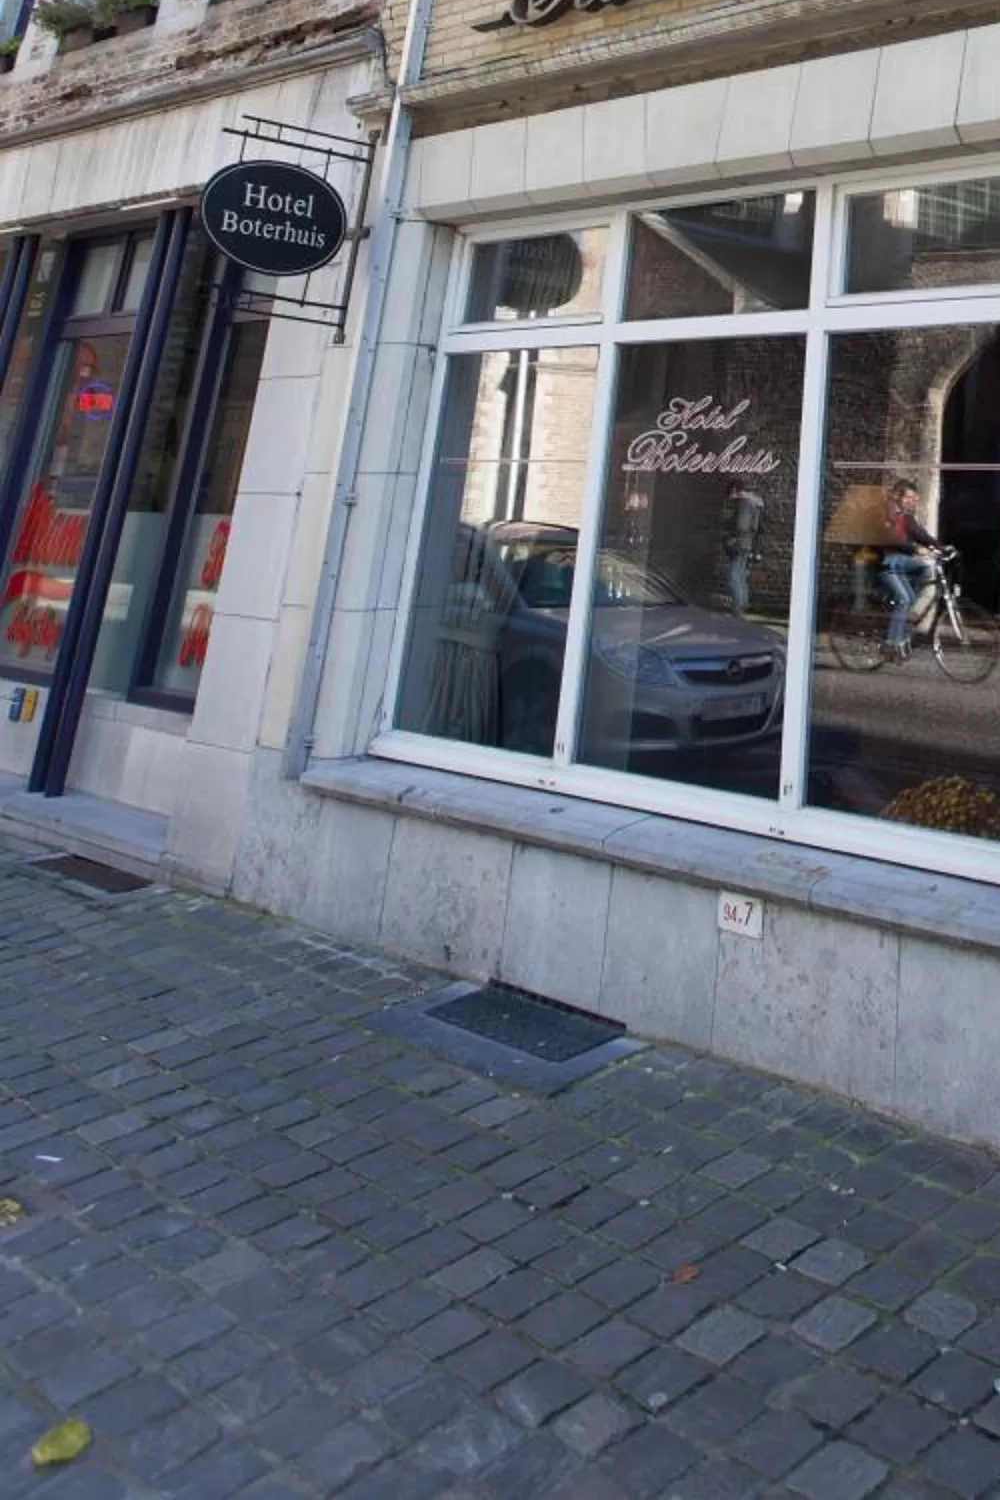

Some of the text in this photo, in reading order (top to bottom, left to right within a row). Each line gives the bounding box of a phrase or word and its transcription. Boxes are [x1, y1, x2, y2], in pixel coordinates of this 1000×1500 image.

[244, 181, 315, 219] Hotel
[221, 209, 326, 249] Boterhuis
[657, 395, 750, 431] Hotel
[621, 429, 781, 473] Boterhuis
